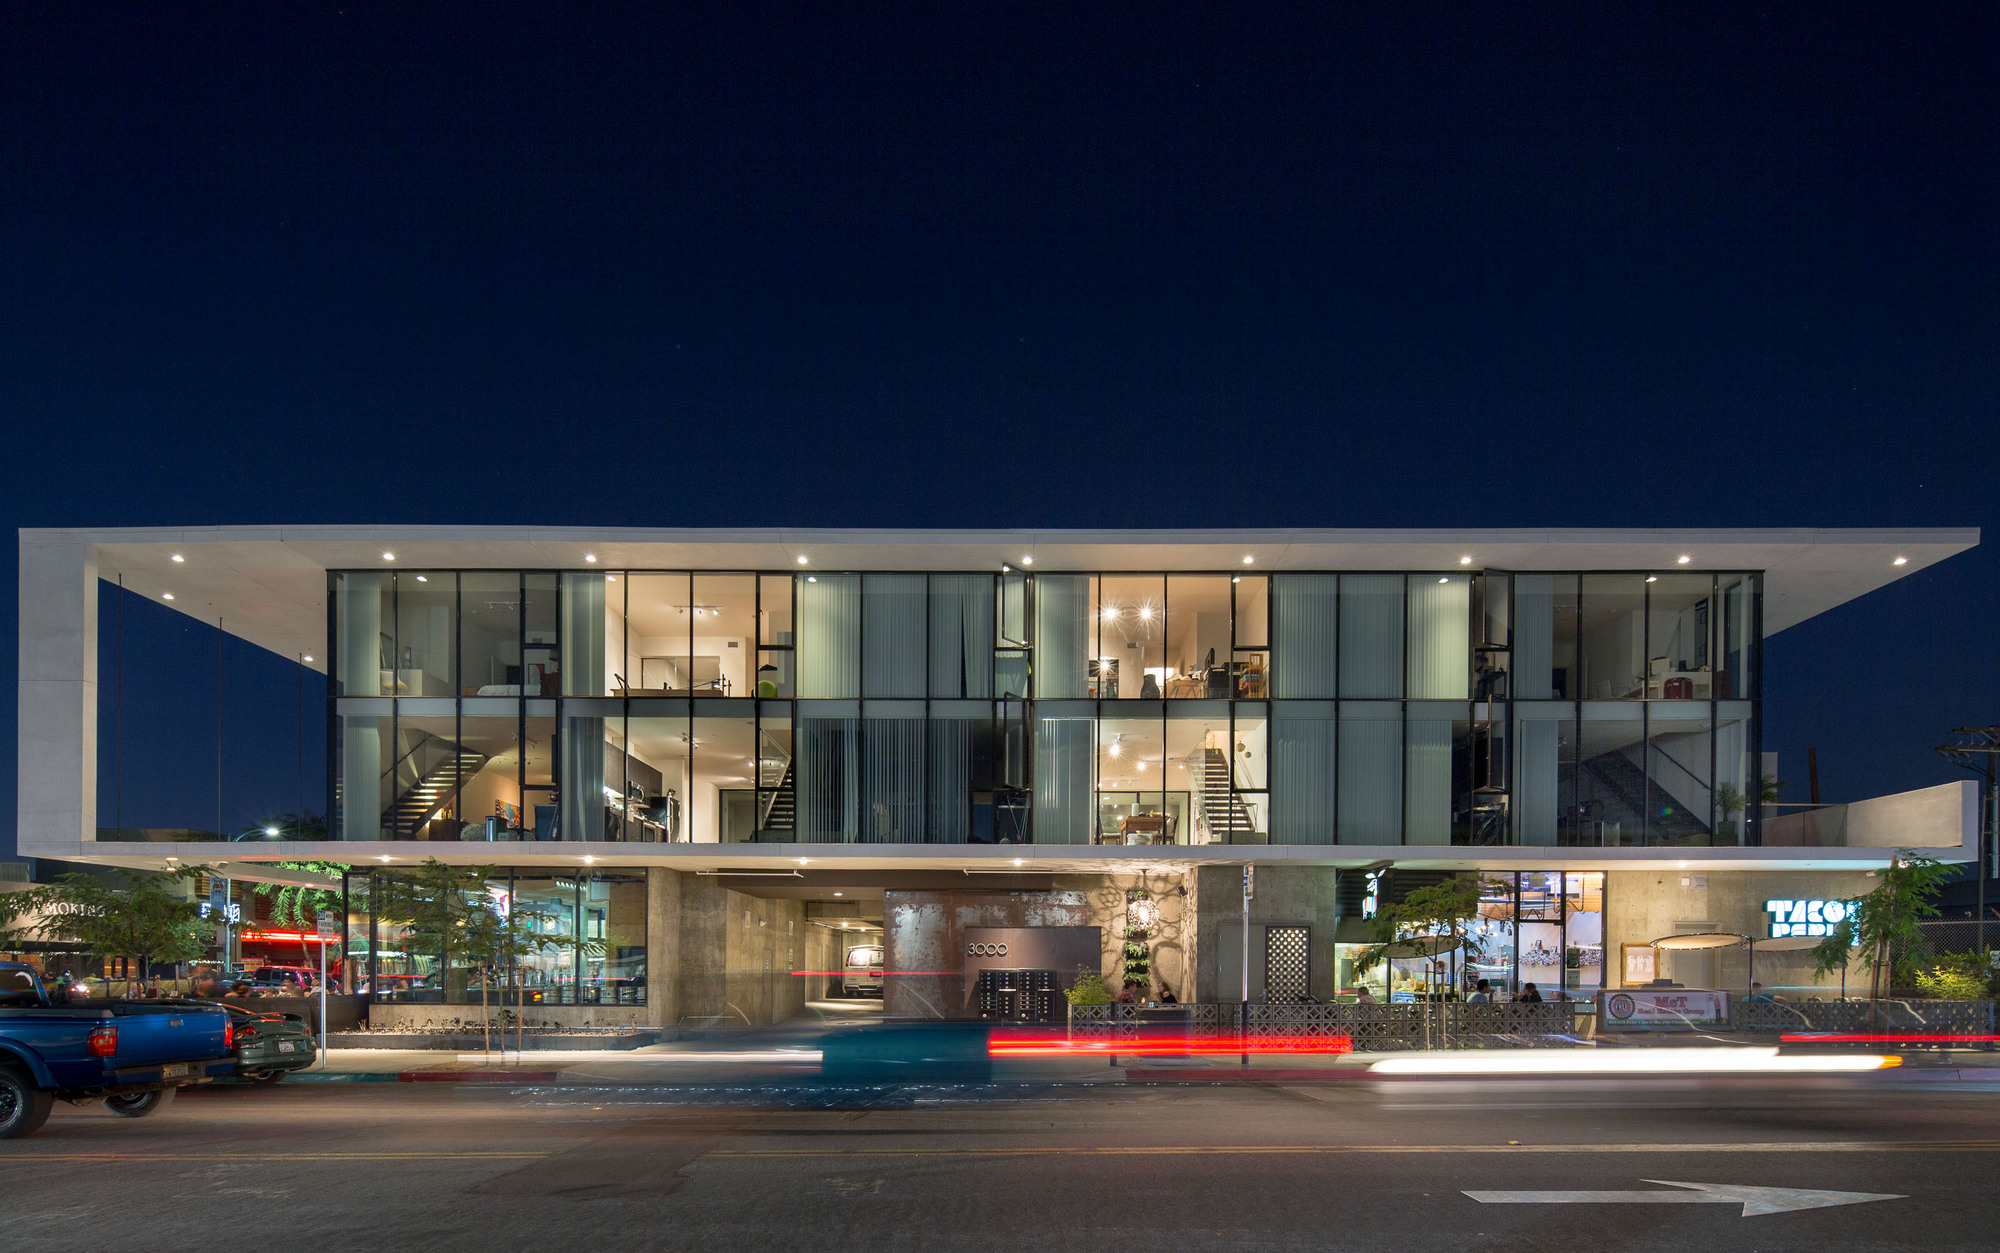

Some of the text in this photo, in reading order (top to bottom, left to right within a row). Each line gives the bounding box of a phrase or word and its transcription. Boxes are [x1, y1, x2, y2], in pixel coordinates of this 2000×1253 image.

[968, 943, 1008, 954] 3000
[1654, 996, 1687, 1008] McT
[1683, 1008, 1705, 1016] Group
